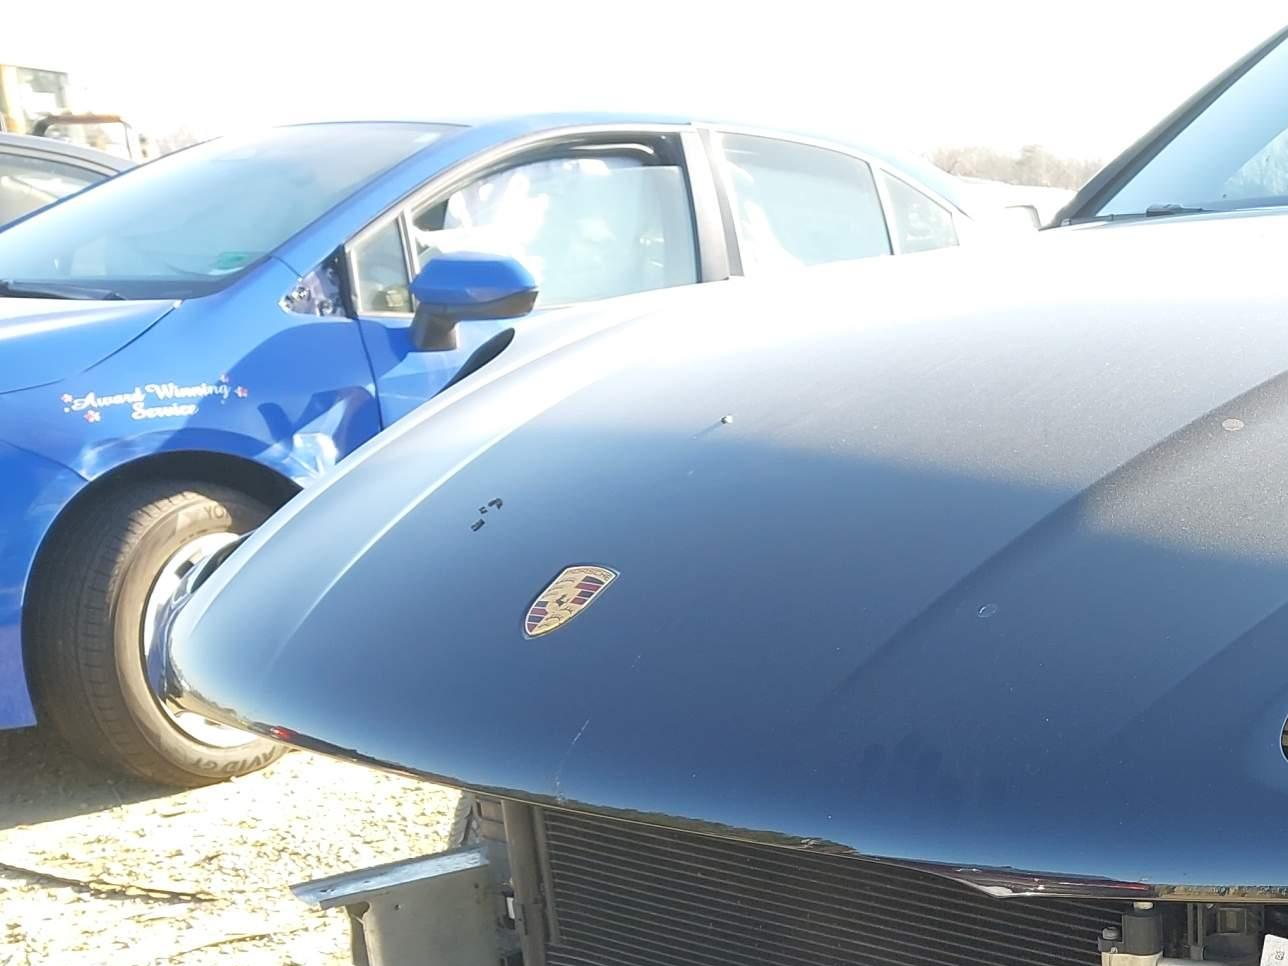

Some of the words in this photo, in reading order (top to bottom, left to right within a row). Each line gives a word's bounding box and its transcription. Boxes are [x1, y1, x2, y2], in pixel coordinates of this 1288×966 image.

[71, 386, 146, 411] Award
[144, 382, 231, 399] Winning
[131, 402, 199, 420] Service
